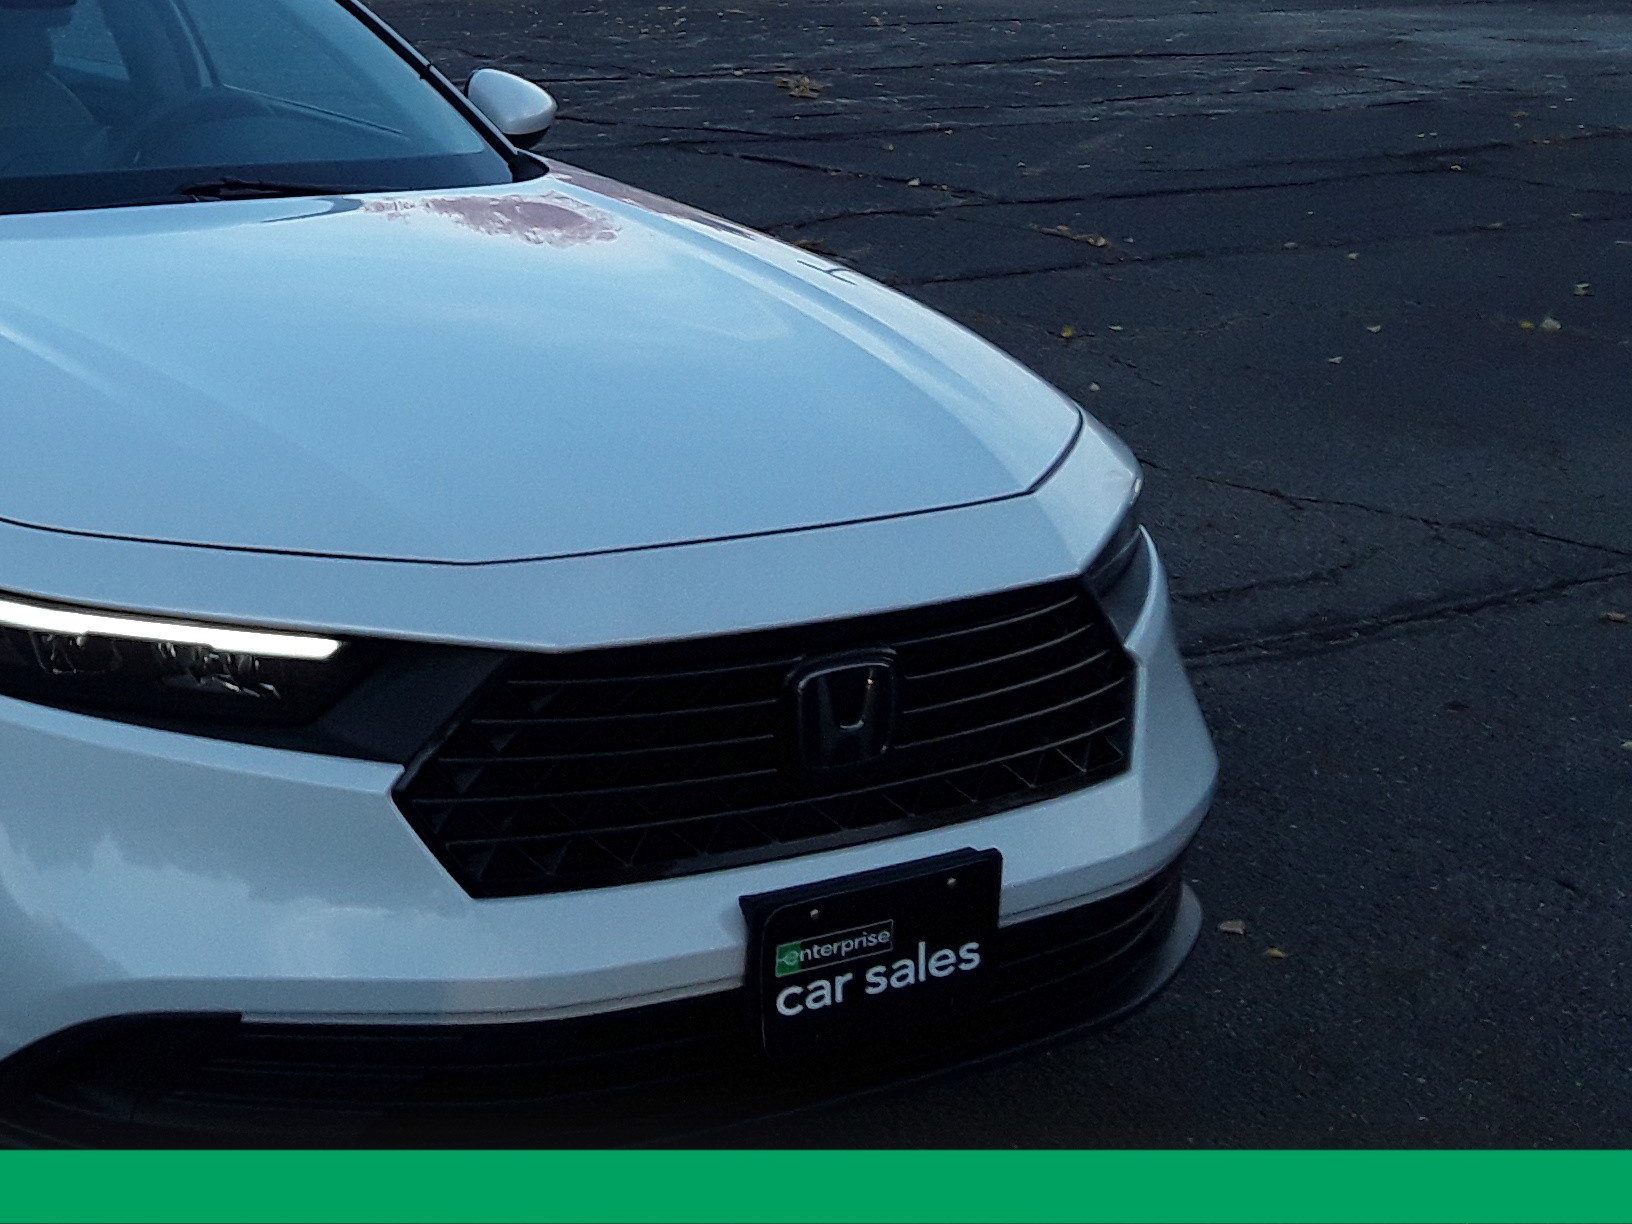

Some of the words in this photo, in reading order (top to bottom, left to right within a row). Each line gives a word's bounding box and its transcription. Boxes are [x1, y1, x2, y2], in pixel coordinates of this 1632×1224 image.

[783, 930, 891, 968] enterprise
[776, 971, 853, 1017] car
[864, 940, 982, 995] sales
